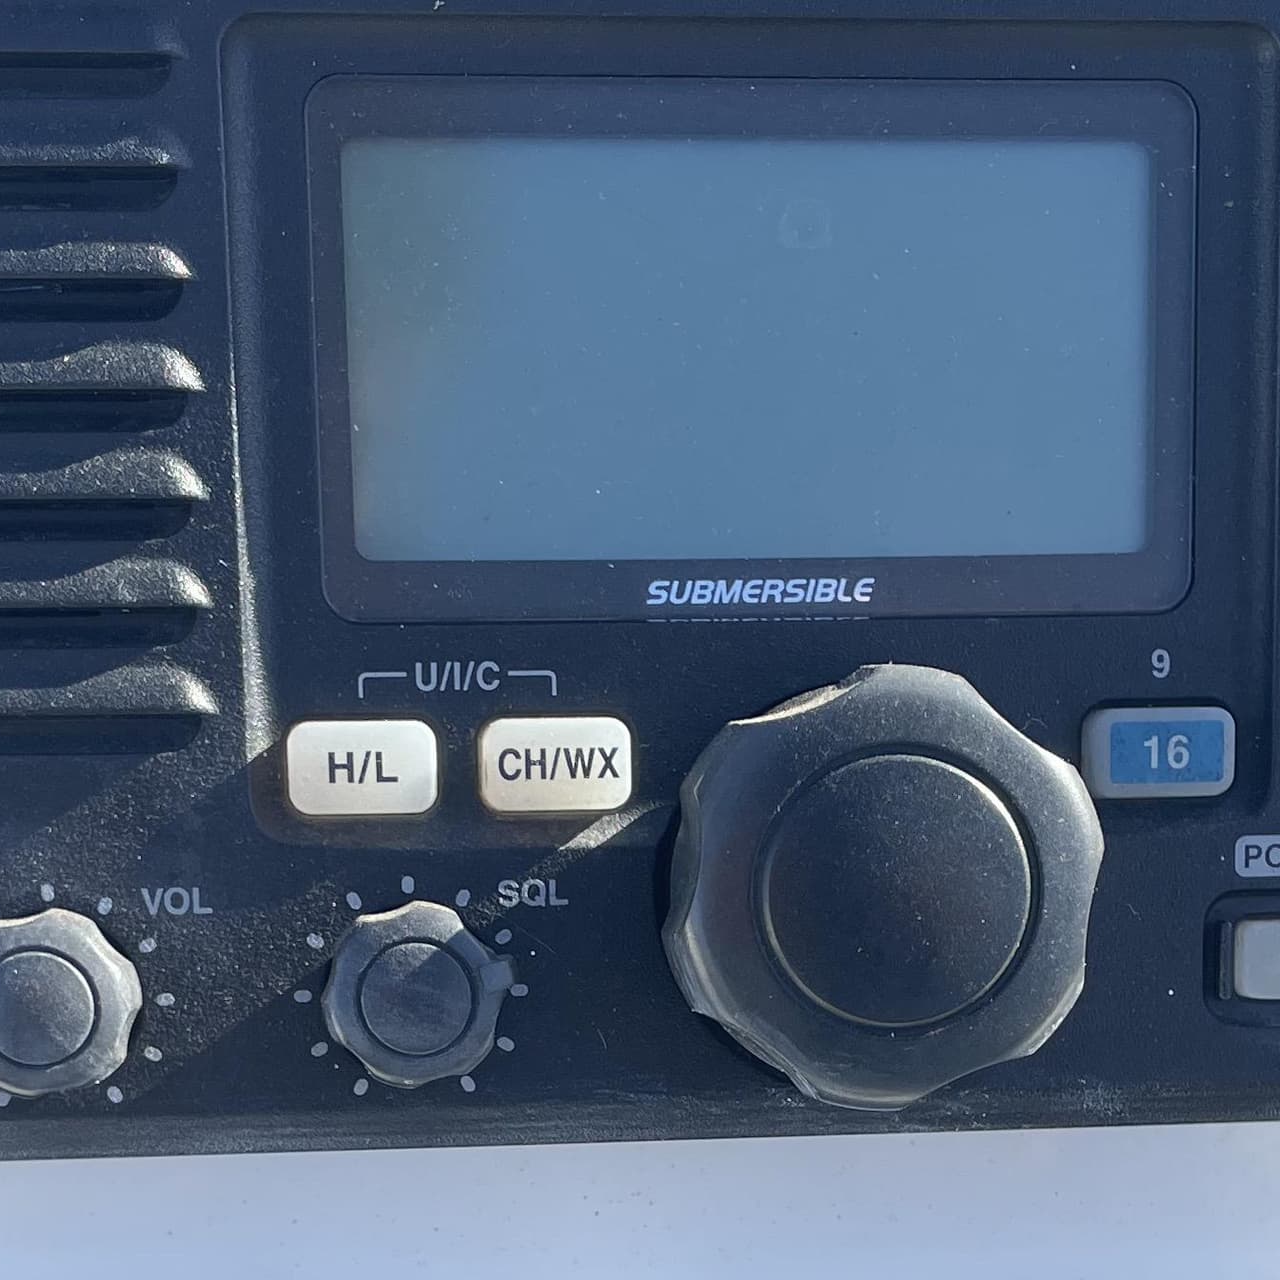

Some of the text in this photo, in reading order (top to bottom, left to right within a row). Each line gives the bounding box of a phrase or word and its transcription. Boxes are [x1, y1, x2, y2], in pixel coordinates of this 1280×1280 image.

[646, 577, 875, 605] SUBMERSIBLE
[414, 661, 501, 692] U/I/C
[1150, 648, 1171, 678] 9
[497, 746, 621, 781] CH/WX
[1143, 734, 1190, 771] 16
[327, 751, 399, 785] H/L
[141, 886, 213, 916] VOL
[497, 878, 569, 908] SQL
